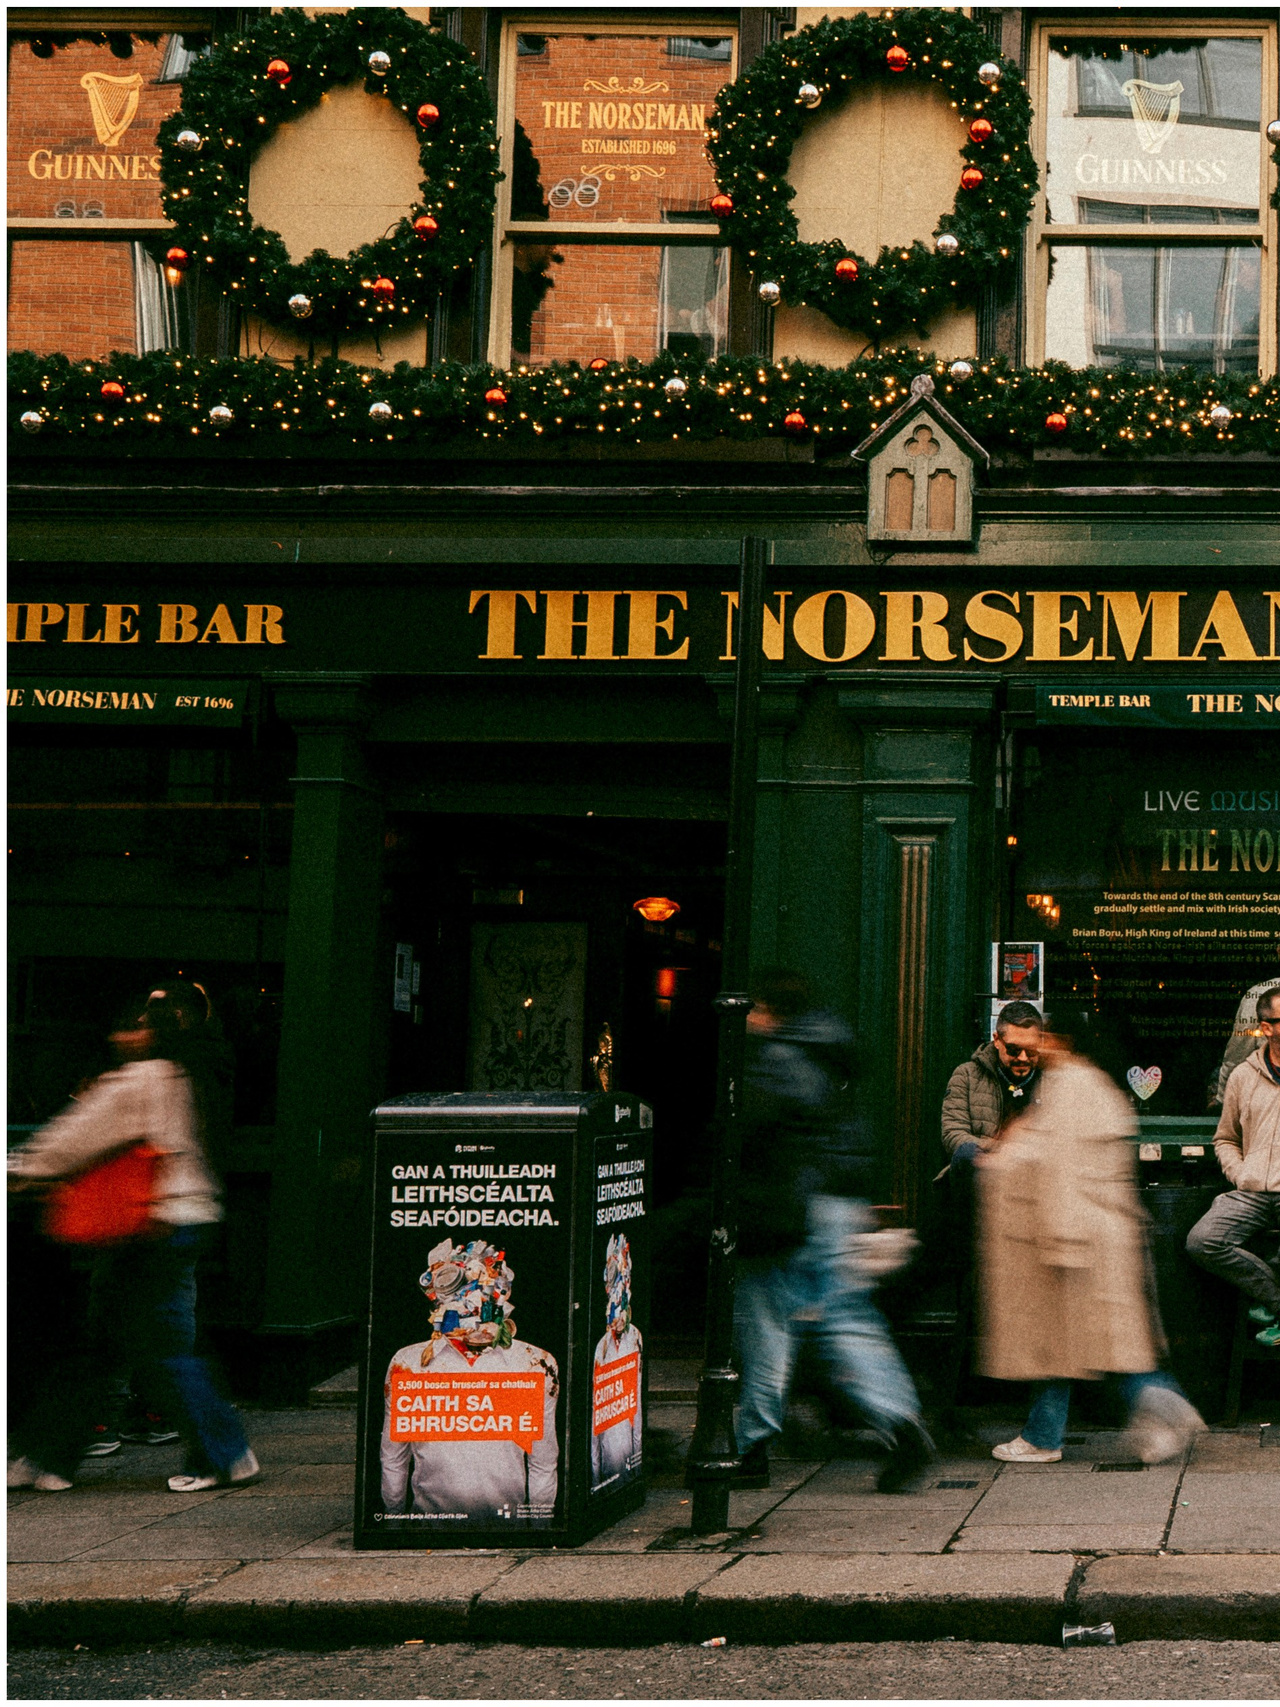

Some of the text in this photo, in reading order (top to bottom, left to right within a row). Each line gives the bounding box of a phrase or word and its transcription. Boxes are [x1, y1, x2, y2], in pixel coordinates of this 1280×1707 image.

[541, 101, 705, 131] THE NORSEMAN
[581, 139, 677, 155] ESTABLISHED 1696
[28, 149, 163, 180] GUINNES
[1075, 154, 1227, 185] GUINNESS
[156, 604, 286, 644] BAR
[469, 590, 690, 660] THE
[32, 689, 157, 709] NORSEMAN
[175, 696, 201, 707] EST
[204, 697, 234, 710] 1696
[1049, 694, 1114, 707] TEMPLE
[1119, 695, 1151, 707] BAR
[1187, 694, 1243, 712] THE
[1144, 790, 1200, 812] LIVE
[1156, 829, 1219, 872] THE
[1103, 892, 1141, 901] Towards
[1144, 892, 1157, 901] the
[1160, 892, 1177, 901] end
[1180, 892, 1190, 901] of
[1191, 892, 1206, 901] the
[1208, 892, 1223, 901] 8th
[1226, 893, 1260, 903] century
[1094, 904, 1138, 914] gradually
[1140, 904, 1165, 913] settle
[1167, 904, 1185, 913] and
[1187, 904, 1204, 913] mix
[1206, 904, 1226, 913] with
[1228, 904, 1248, 914] Irish
[1073, 929, 1096, 938] Brian
[1099, 929, 1124, 940] Boru,
[1125, 929, 1147, 940] High
[1150, 929, 1172, 940] King
[1173, 929, 1183, 938] of
[1184, 929, 1217, 938] Ireland
[1219, 930, 1228, 938] at
[1230, 929, 1248, 938] this
[1249, 929, 1270, 938] time
[392, 1164, 556, 1179] GAN A THUILLEADH
[597, 1164, 609, 1178] GAN
[614, 1159, 645, 1176] THUILLEADH
[391, 1181, 554, 1203] LEITHSCÉALTA
[597, 1177, 644, 1202] LEITHSCÉALTA
[390, 1205, 559, 1227] SEAFÓIDEACHA.
[596, 1201, 646, 1226] SEAFÓIDEACHA.
[398, 1380, 537, 1391] 3,500 bosca bruscair sa chathair
[595, 1379, 624, 1406] CAITH SA
[396, 1395, 494, 1412] CAITH SA
[595, 1396, 629, 1427] BHRUSCAR
[396, 1411, 539, 1432] BHRUSCAR É.
